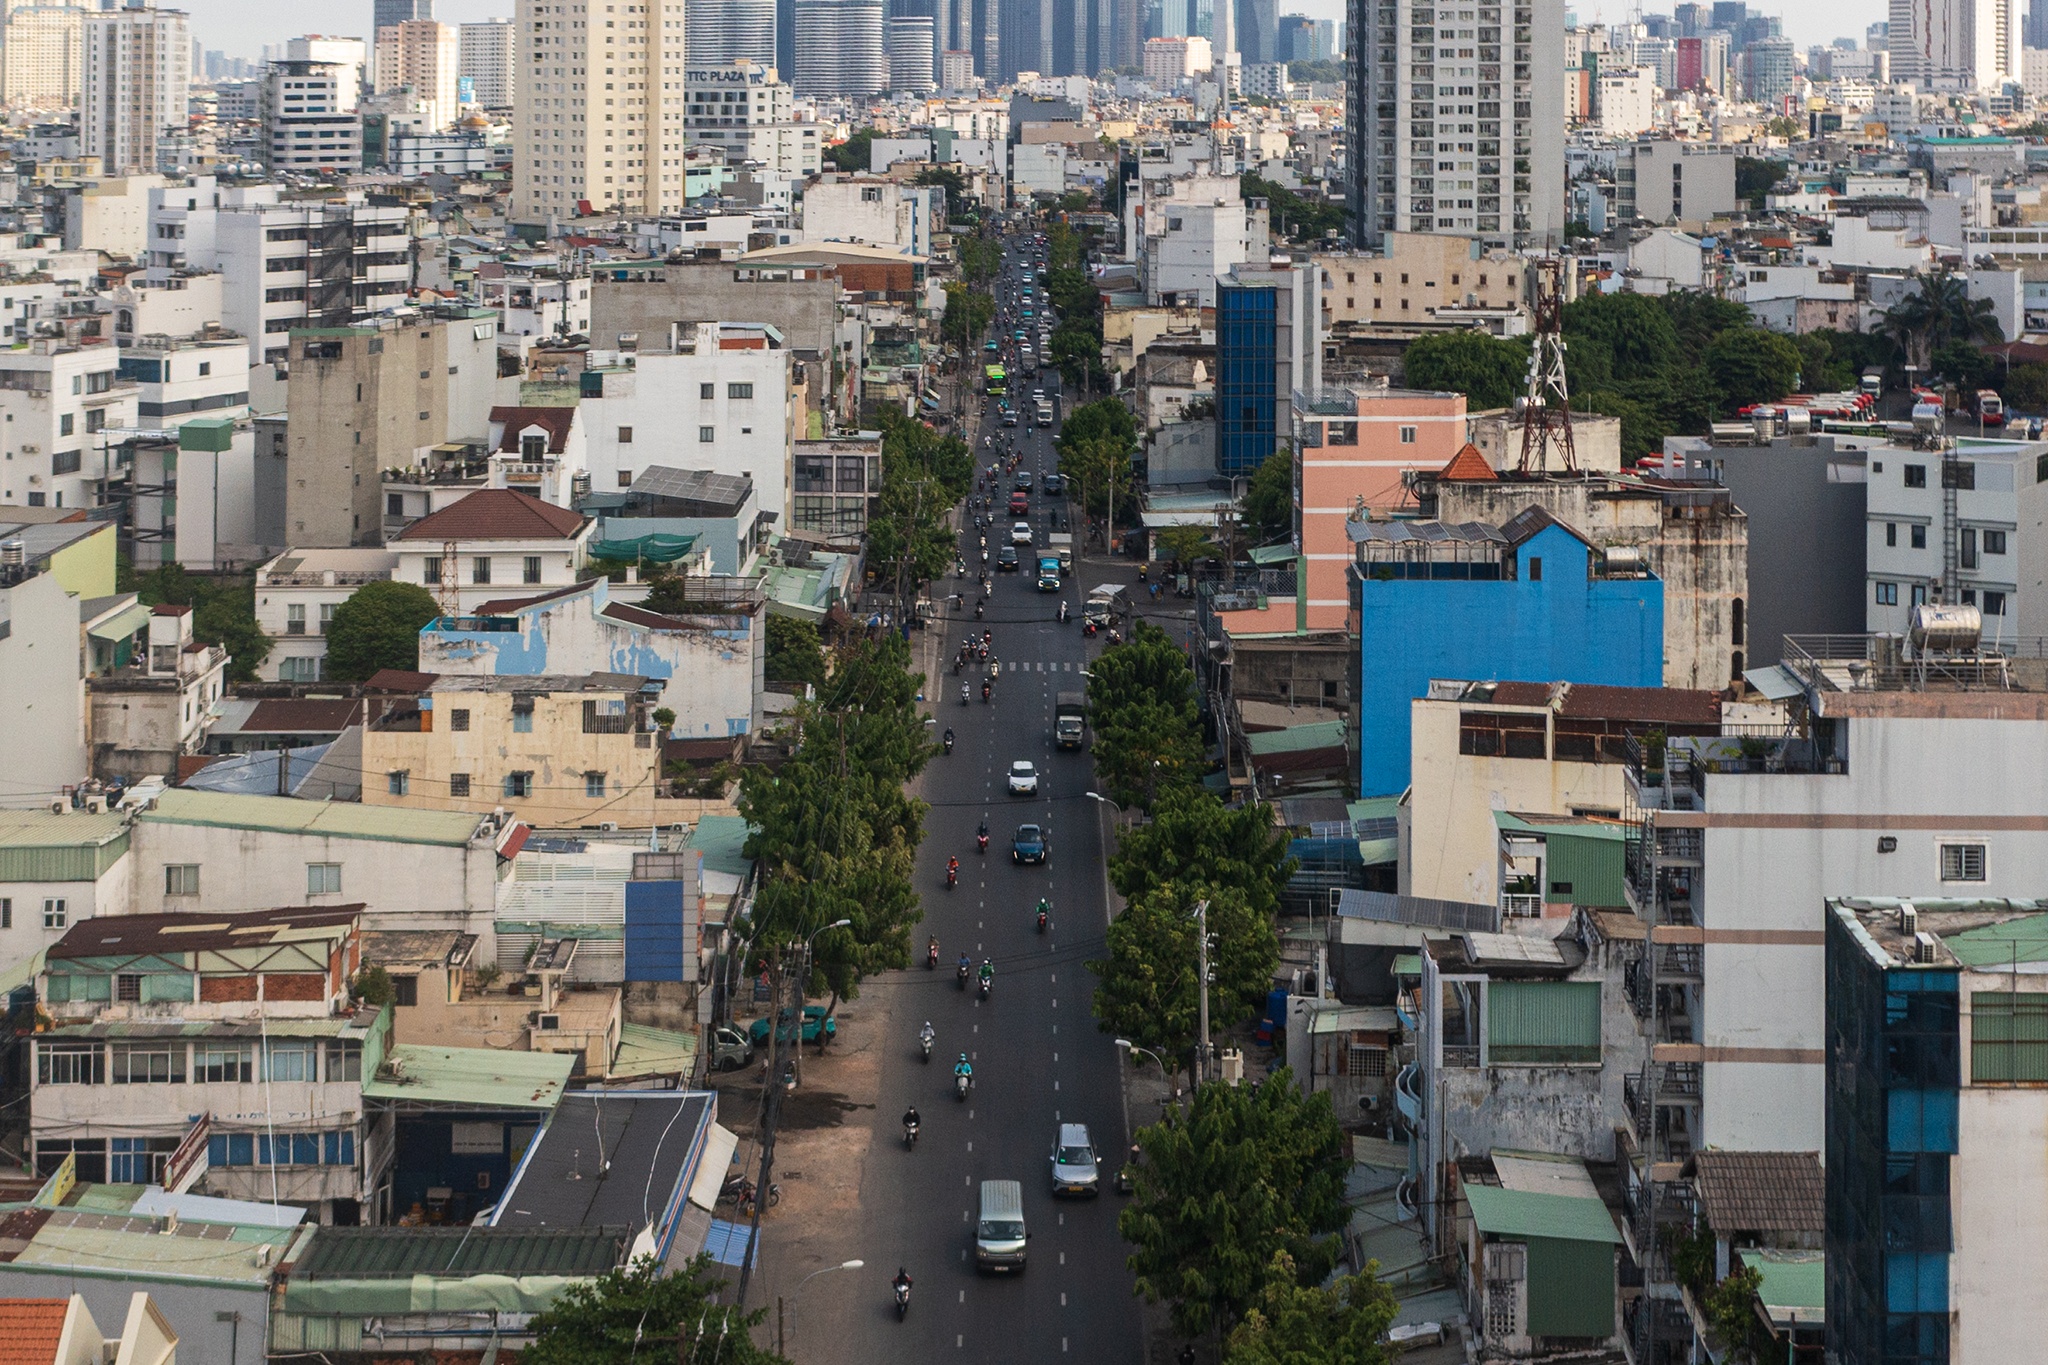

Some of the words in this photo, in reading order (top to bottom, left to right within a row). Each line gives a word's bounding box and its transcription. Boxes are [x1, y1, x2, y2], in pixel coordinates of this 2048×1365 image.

[687, 71, 707, 82] TTC
[710, 71, 745, 82] PLAZA
[749, 73, 763, 84] TTC
